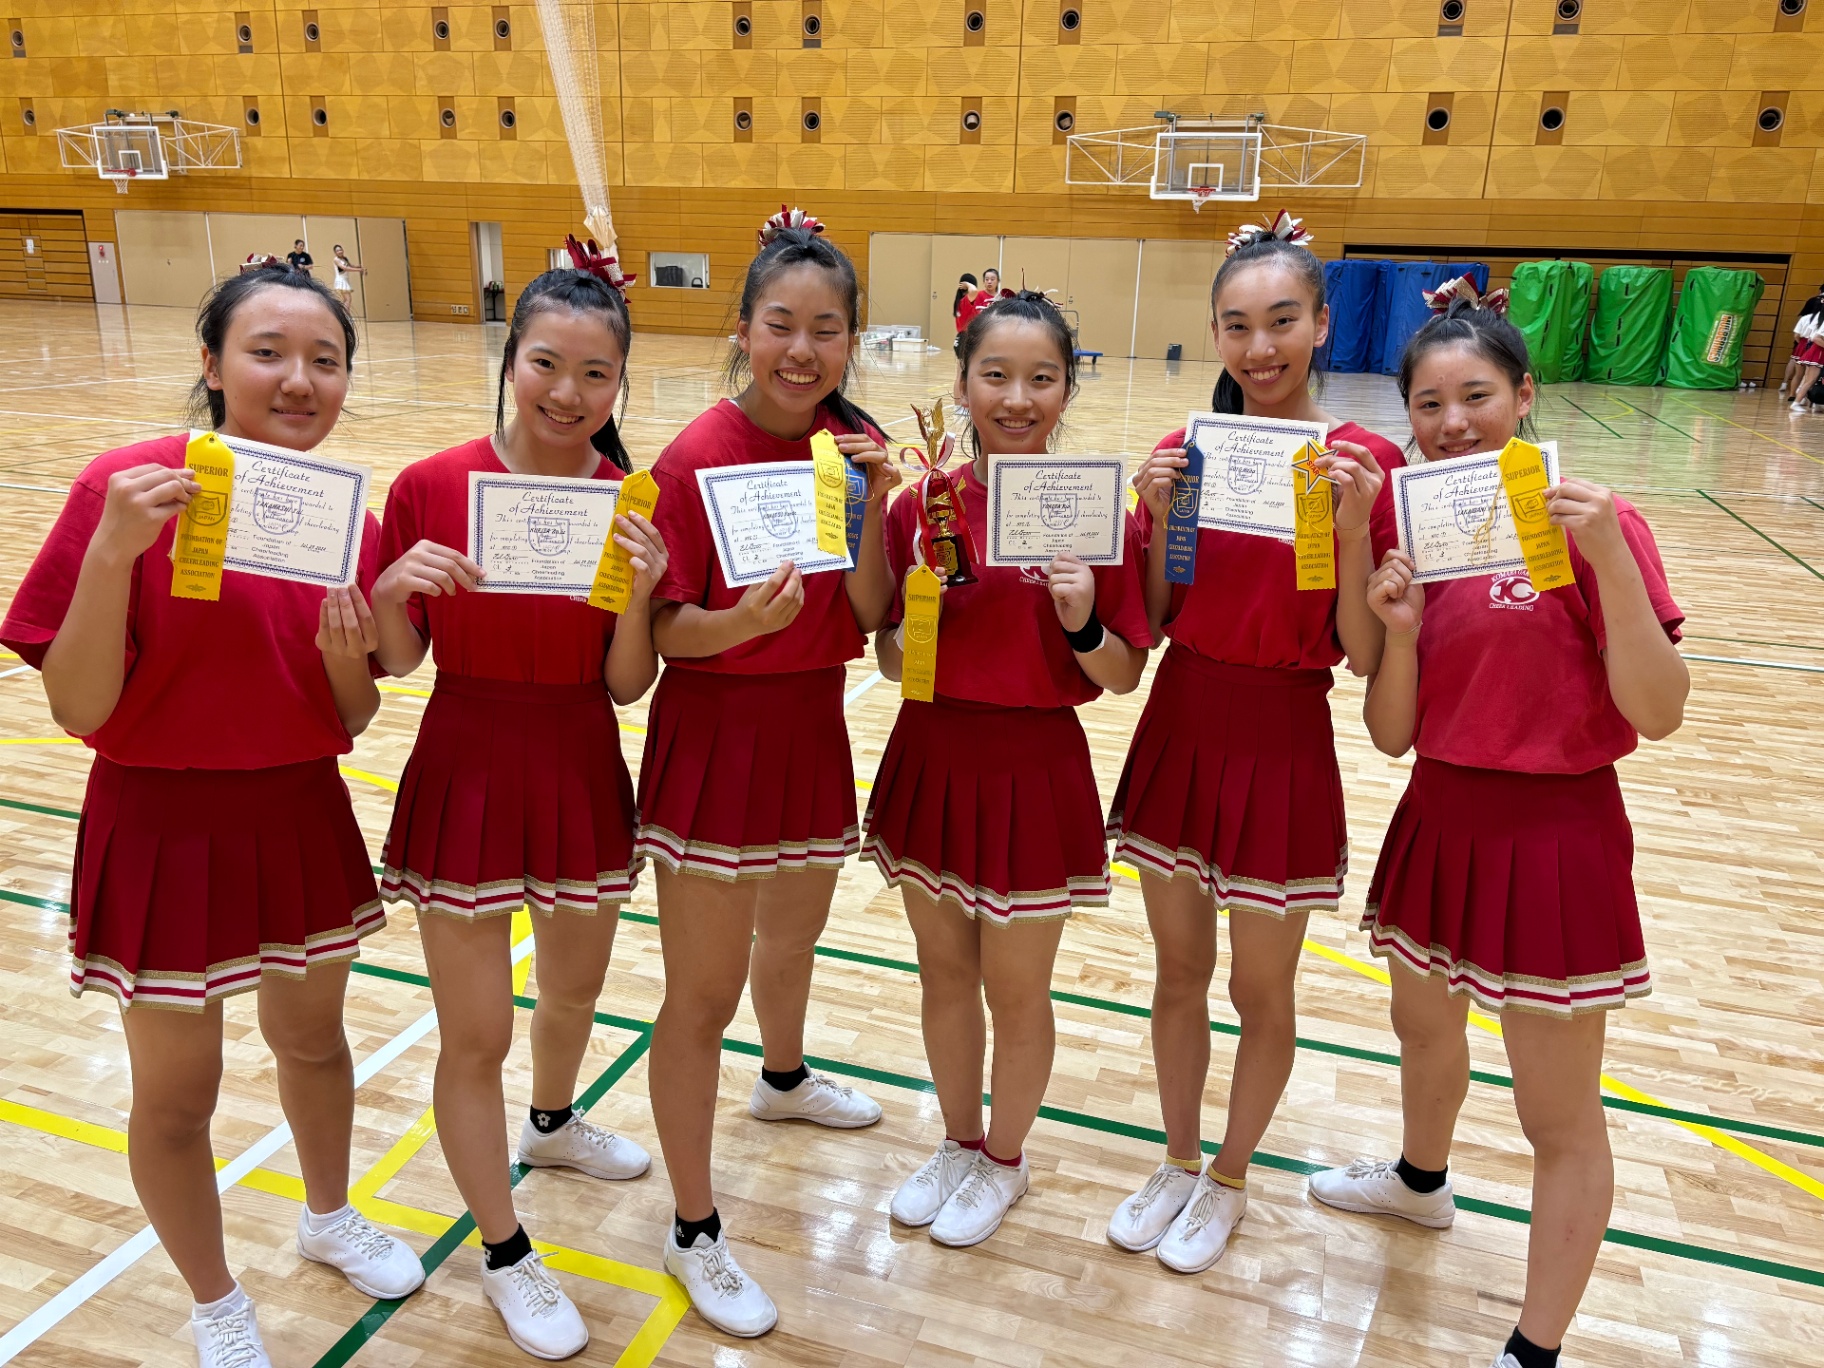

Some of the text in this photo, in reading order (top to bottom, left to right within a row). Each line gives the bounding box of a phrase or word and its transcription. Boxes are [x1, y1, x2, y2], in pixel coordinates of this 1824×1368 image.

[1228, 431, 1273, 444] Certificate
[1215, 441, 1284, 457] of Achievement
[189, 463, 229, 477] SUPERIOR
[252, 460, 311, 482] Certificate
[1035, 469, 1082, 483] Certificate
[1504, 464, 1541, 482] SUPERIOR
[234, 470, 325, 497] of Achievement
[747, 477, 788, 491] Certificate
[1023, 480, 1093, 493] of Achievement
[1445, 471, 1498, 487] Certificate
[522, 491, 574, 505] Certificate
[620, 493, 652, 510] SUPERIOR
[739, 489, 802, 505] of Achievement
[1433, 487, 1444, 502] of
[508, 502, 589, 517] of Achievement
